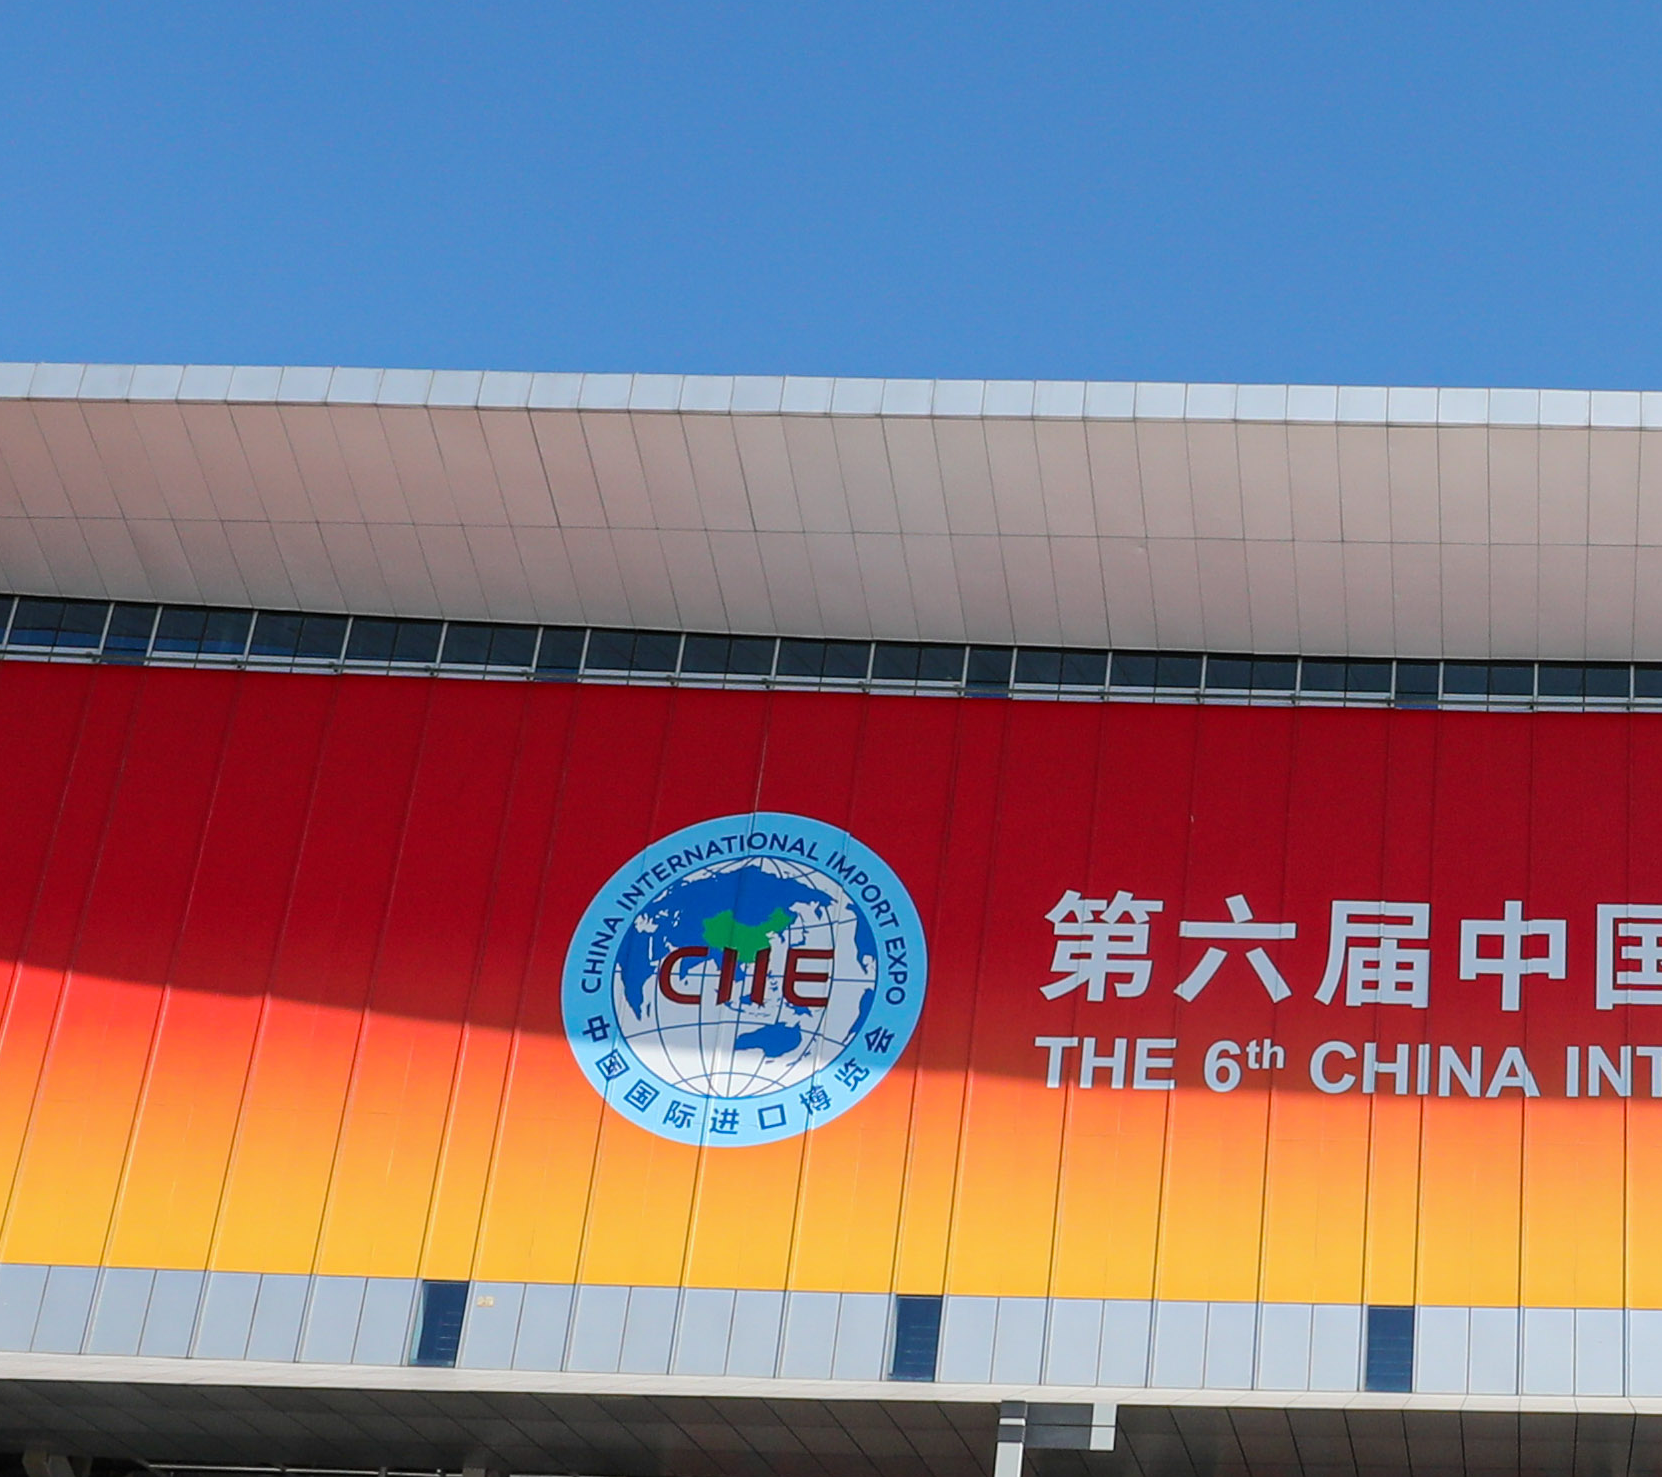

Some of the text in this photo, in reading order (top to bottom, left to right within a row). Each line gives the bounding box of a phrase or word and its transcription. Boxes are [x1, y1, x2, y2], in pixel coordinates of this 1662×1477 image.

[581, 832, 909, 1006] CHINA INTERNATIONAL IMPORT EXPO
[658, 946, 835, 1007] CIIE
[582, 1015, 895, 1135] 中国国际进口博览会
[1034, 1036, 1177, 1090] THE
[1203, 1038, 1285, 1093] 6th
[1309, 1041, 1540, 1099] CHINA
